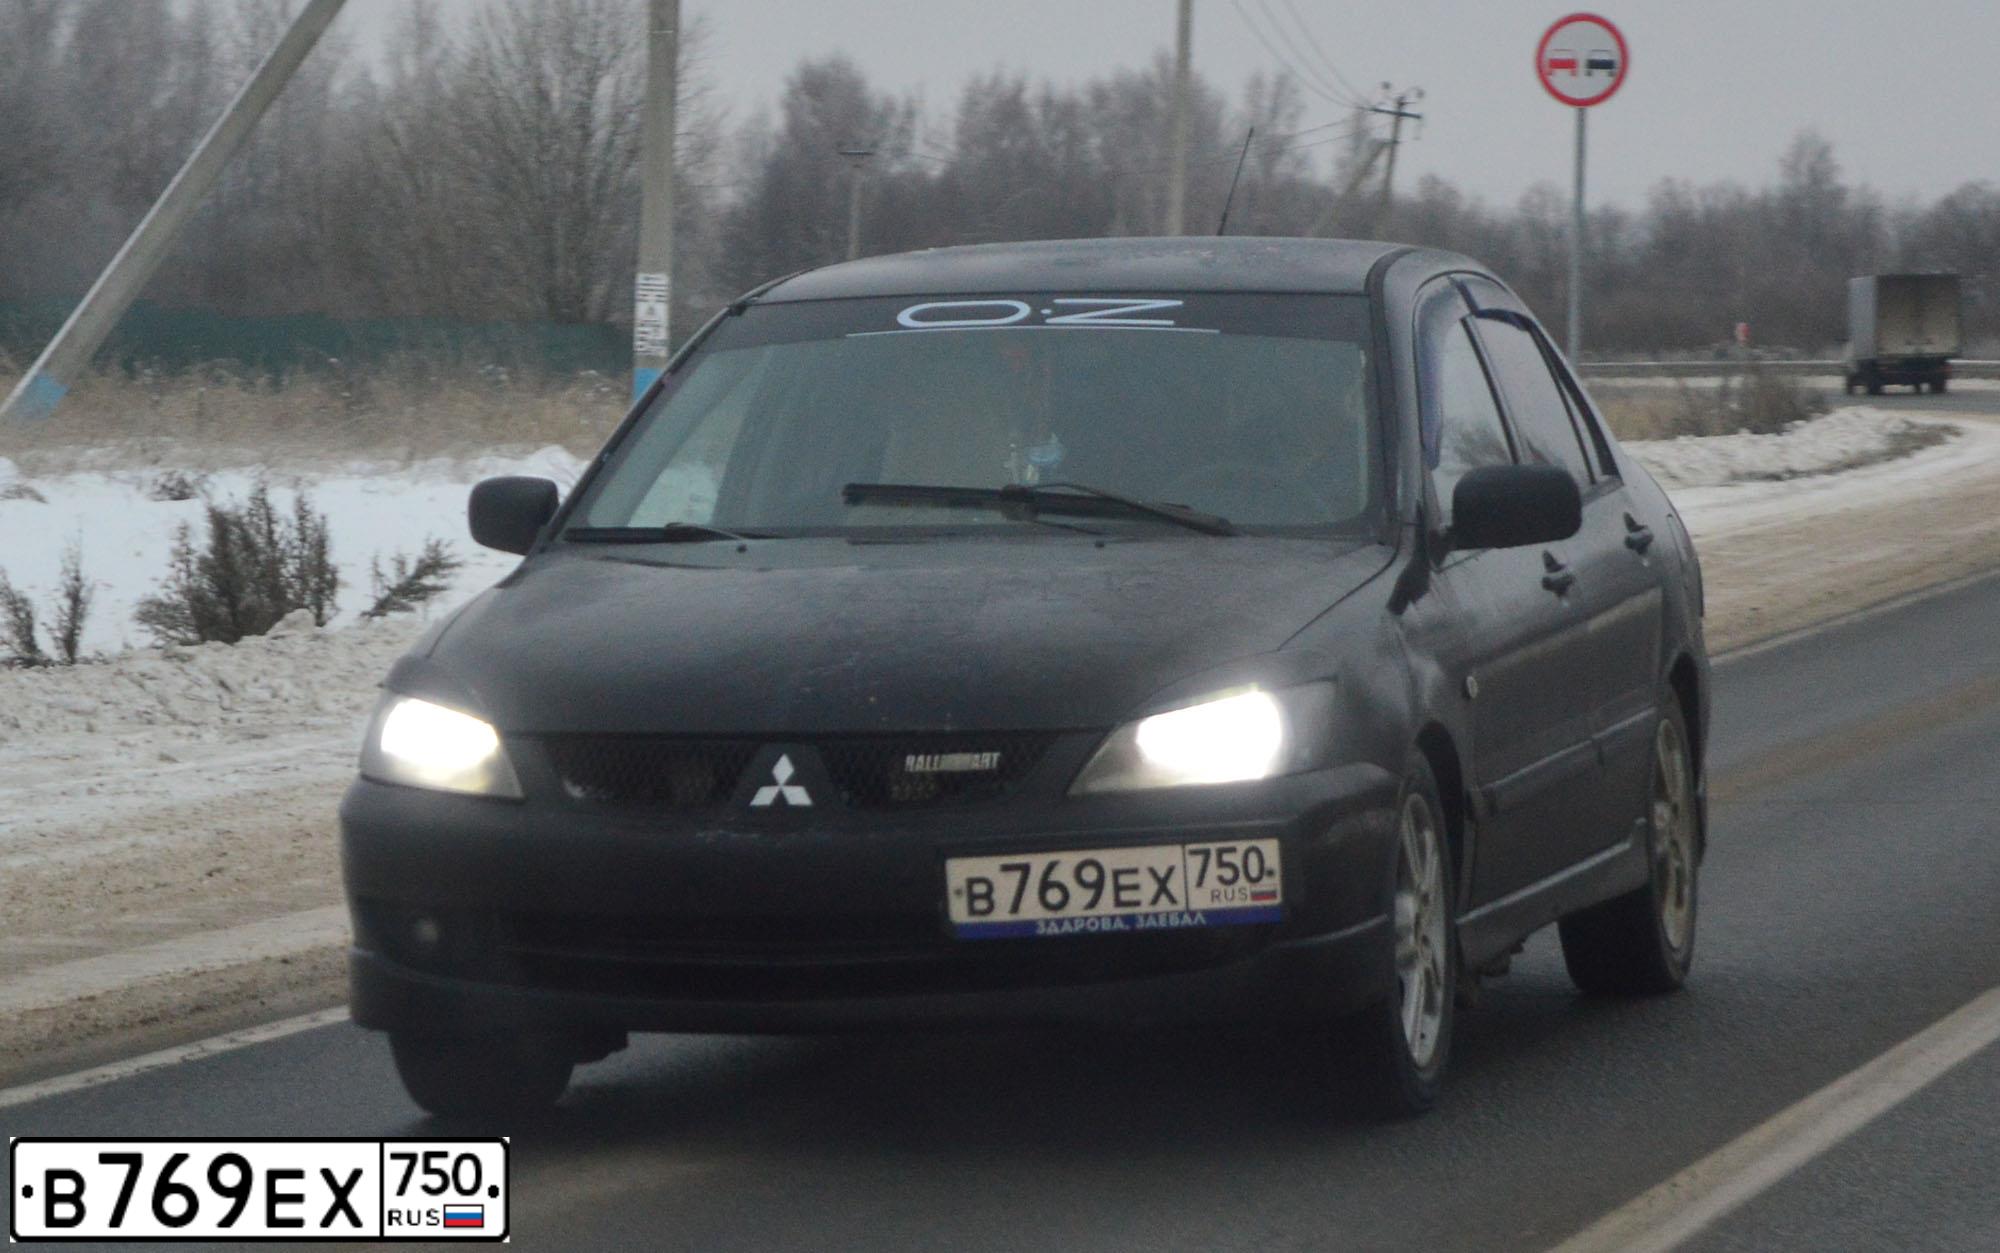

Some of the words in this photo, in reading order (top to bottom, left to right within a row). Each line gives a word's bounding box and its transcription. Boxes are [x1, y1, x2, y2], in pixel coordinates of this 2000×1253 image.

[1188, 845, 1266, 888] 750
[966, 858, 1178, 917] В769ЕХ
[1210, 887, 1248, 903] RUS
[1135, 911, 1207, 929] ЗАЕБАЛ
